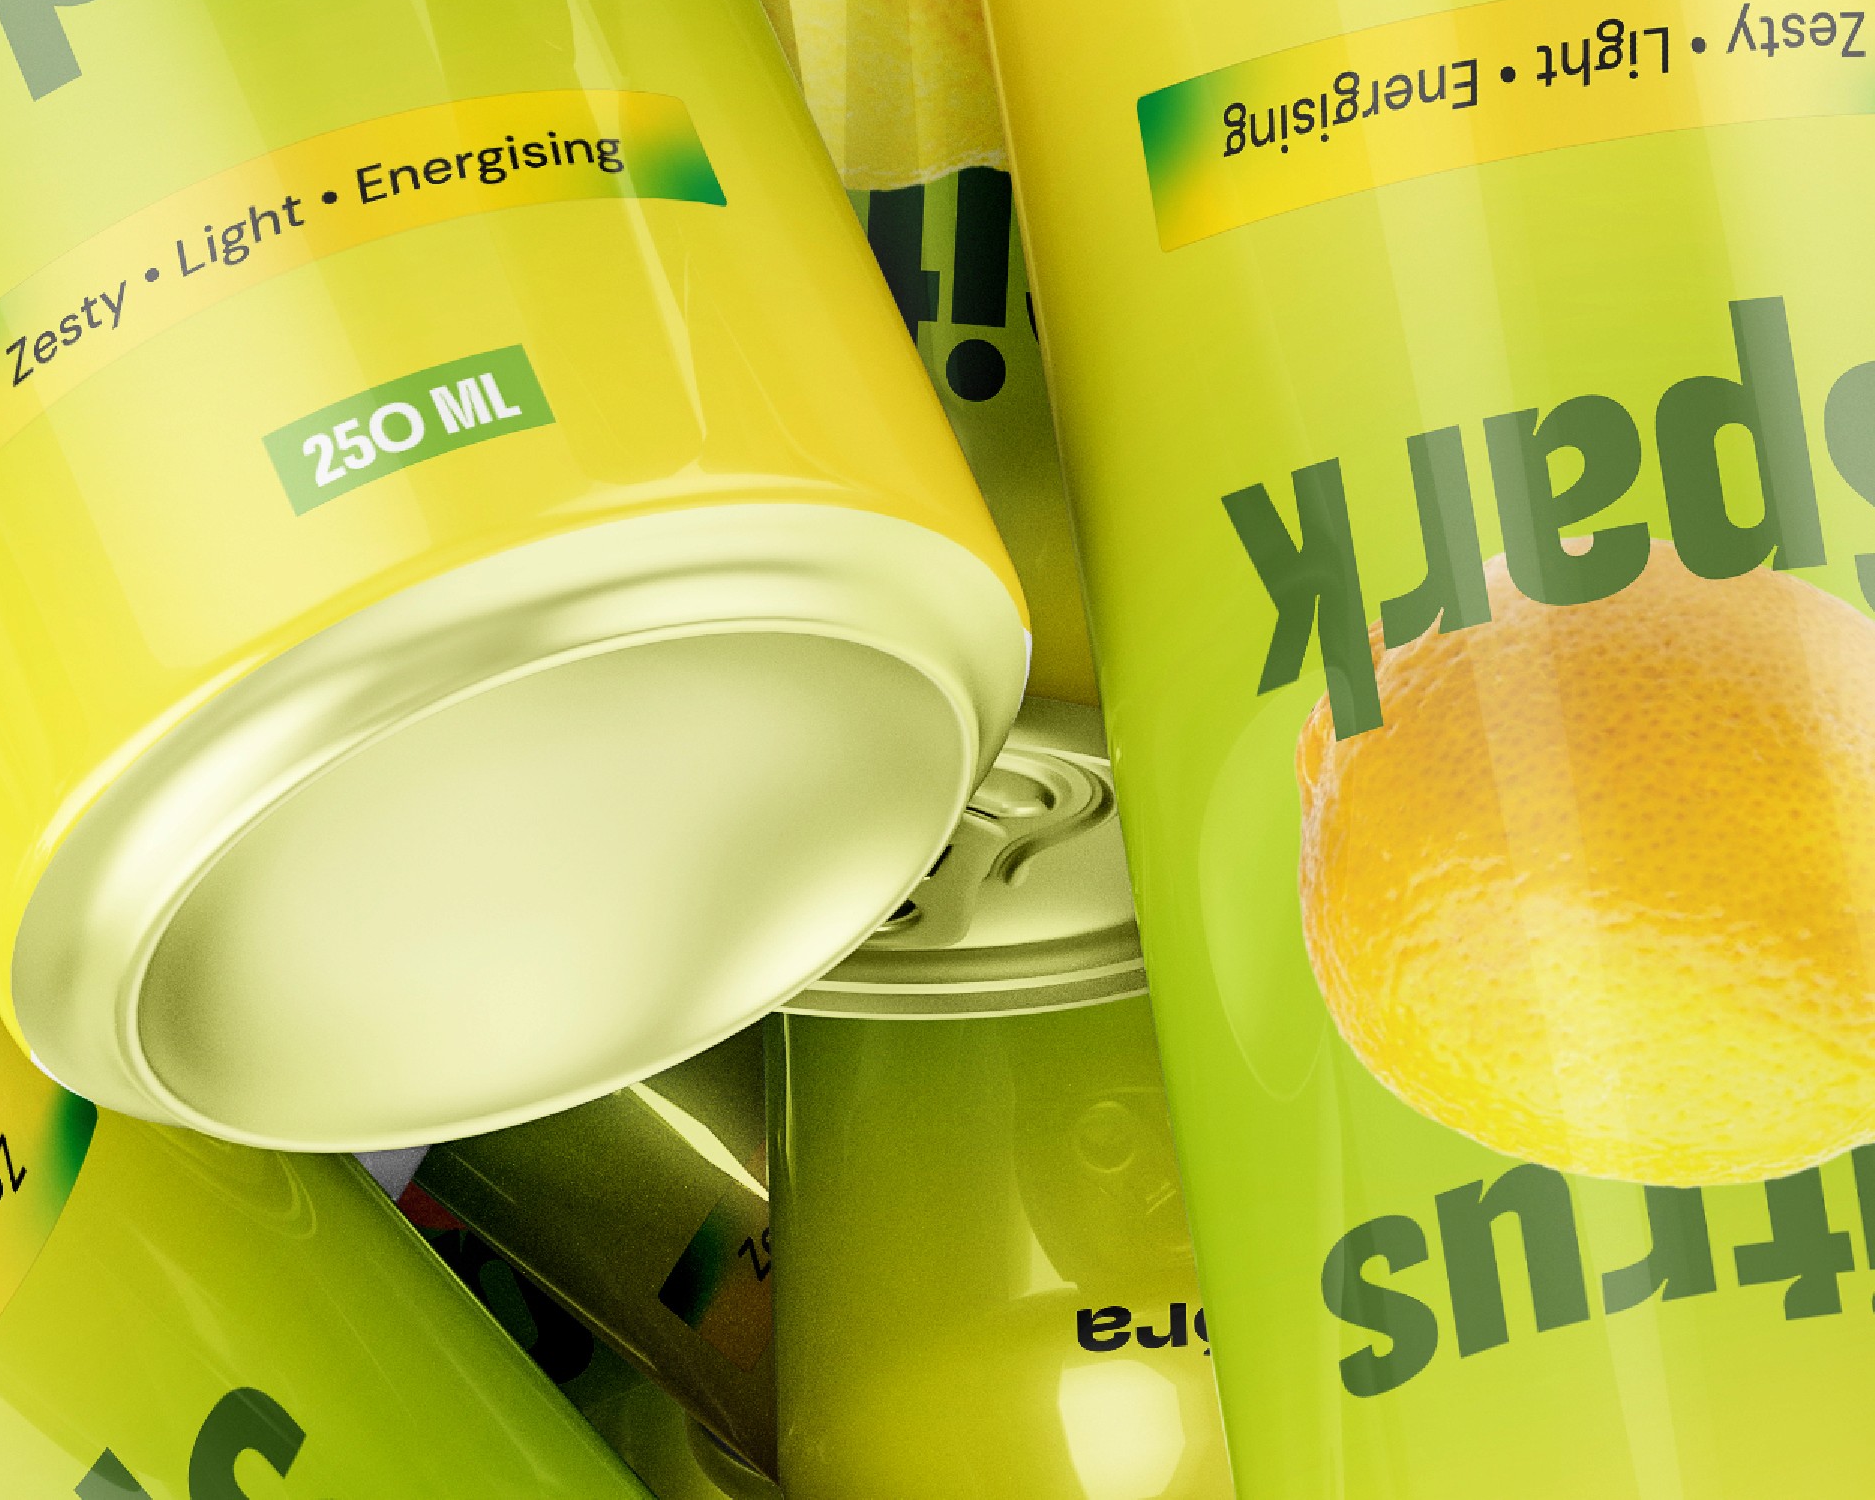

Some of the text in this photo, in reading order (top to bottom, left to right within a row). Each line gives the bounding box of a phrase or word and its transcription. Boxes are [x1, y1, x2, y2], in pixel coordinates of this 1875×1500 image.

[1221, 7, 1866, 157] Zesty Light Energising
[5, 129, 626, 386] Zesty Light Energising
[302, 372, 522, 487] 250 ML
